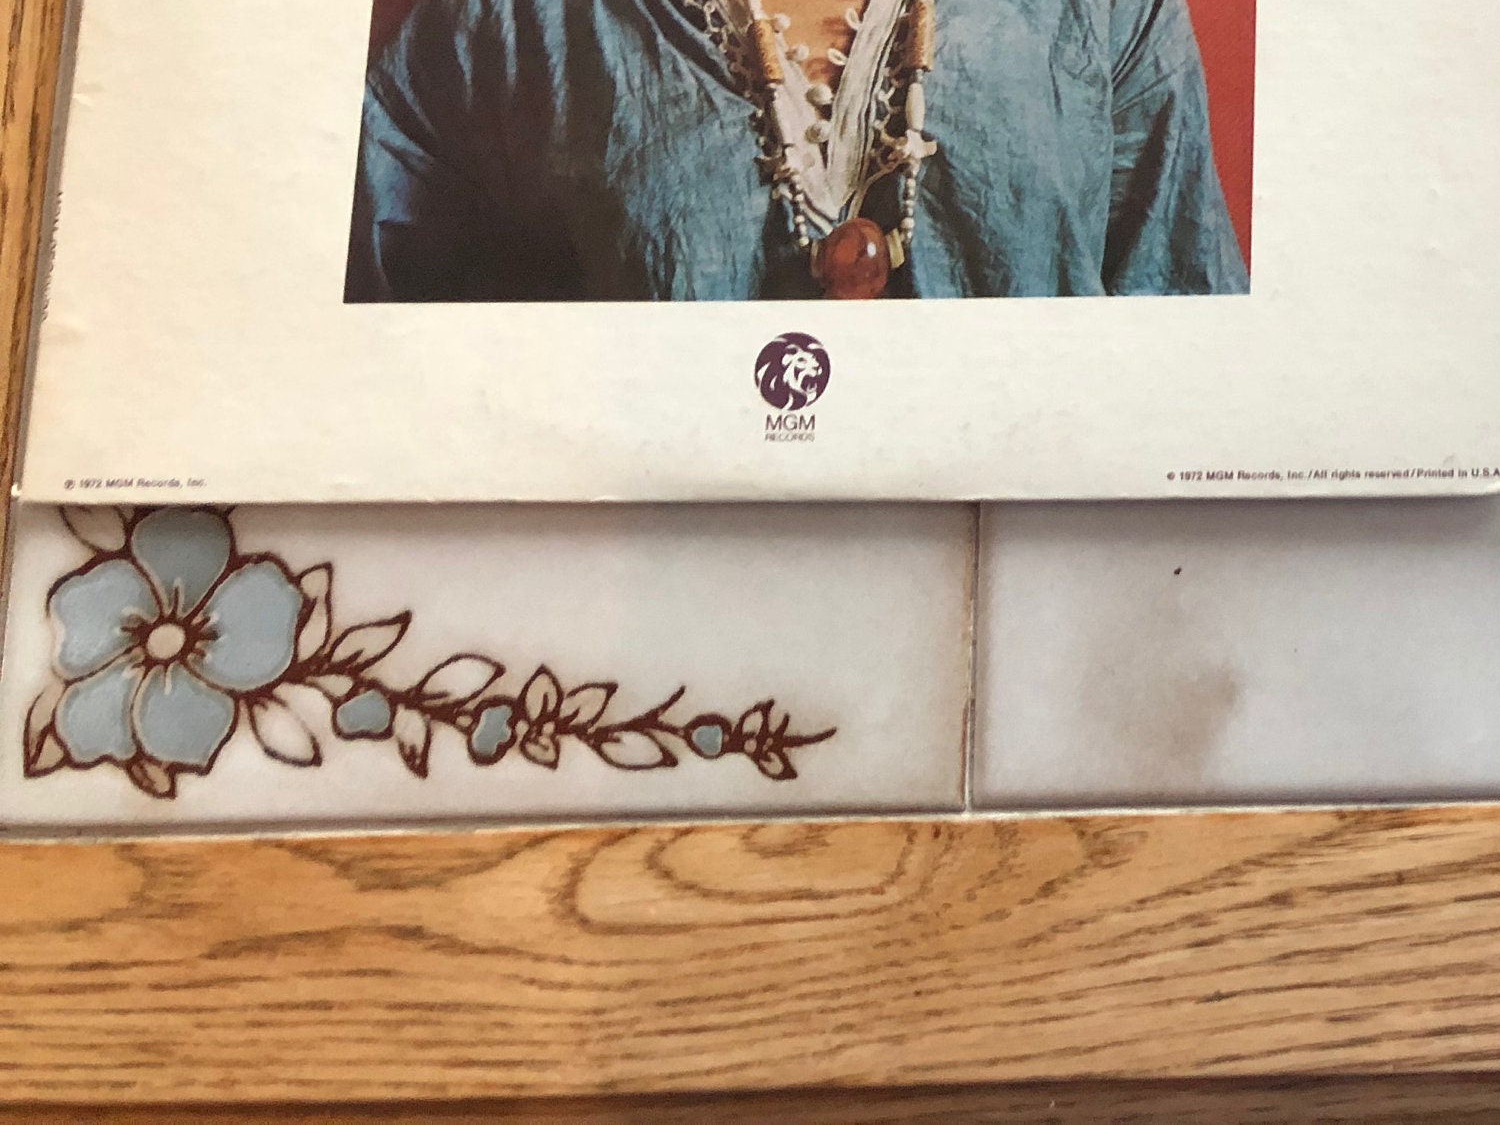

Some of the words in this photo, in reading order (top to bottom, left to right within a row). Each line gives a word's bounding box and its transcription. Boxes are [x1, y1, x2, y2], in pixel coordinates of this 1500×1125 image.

[766, 414, 816, 431] MGM
[1180, 472, 1203, 481] 1972
[1206, 471, 1234, 480] MGM
[1331, 468, 1361, 481] rights
